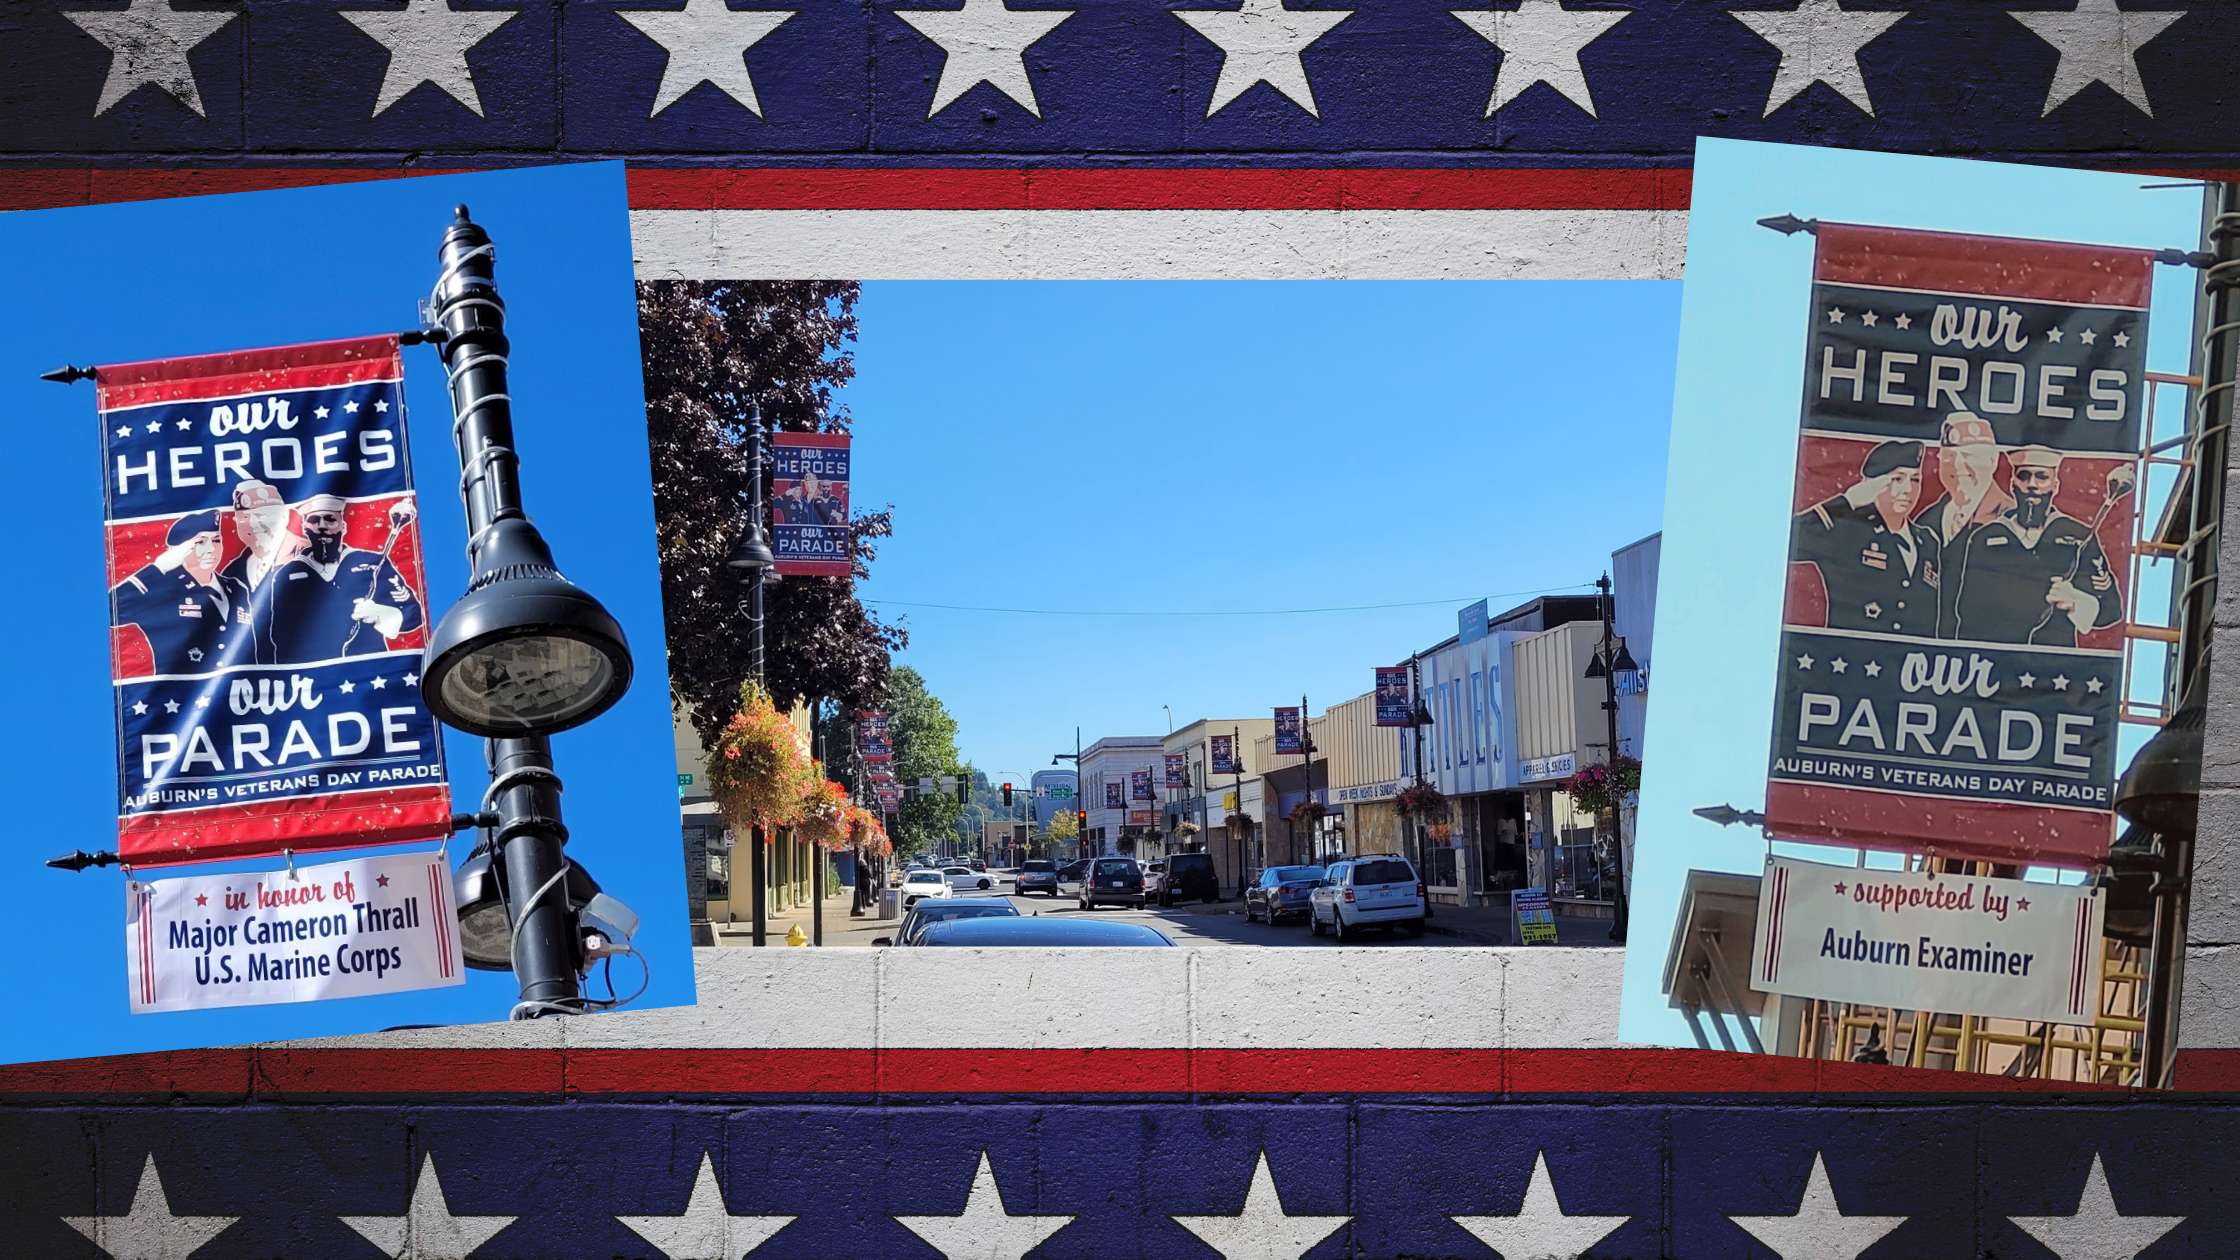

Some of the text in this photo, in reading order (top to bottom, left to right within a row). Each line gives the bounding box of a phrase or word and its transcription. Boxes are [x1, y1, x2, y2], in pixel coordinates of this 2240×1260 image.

[1930, 304, 2029, 352] our
[1820, 346, 2128, 421] HEROES
[209, 397, 299, 436] our
[117, 430, 396, 494] HEROES
[777, 460, 847, 474] HEROES
[801, 449, 823, 459] our
[779, 539, 845, 552] PARADE
[801, 528, 824, 538] our
[229, 674, 323, 715] our
[1900, 652, 2000, 697] our
[142, 706, 421, 778] PARADE
[1799, 693, 2095, 768] PARADE
[124, 764, 441, 809] AUBURN'S VETERANS DAY PARADE
[1773, 757, 2107, 801] AUBURN'S VETERANS DAY PARADE
[225, 871, 356, 911] in honor of
[1853, 883, 2009, 921] supported by
[169, 897, 420, 954] Major Cameron Thrall
[195, 943, 402, 985] U.S. Marine Corps
[1820, 927, 2034, 976] Auburn Examiner
